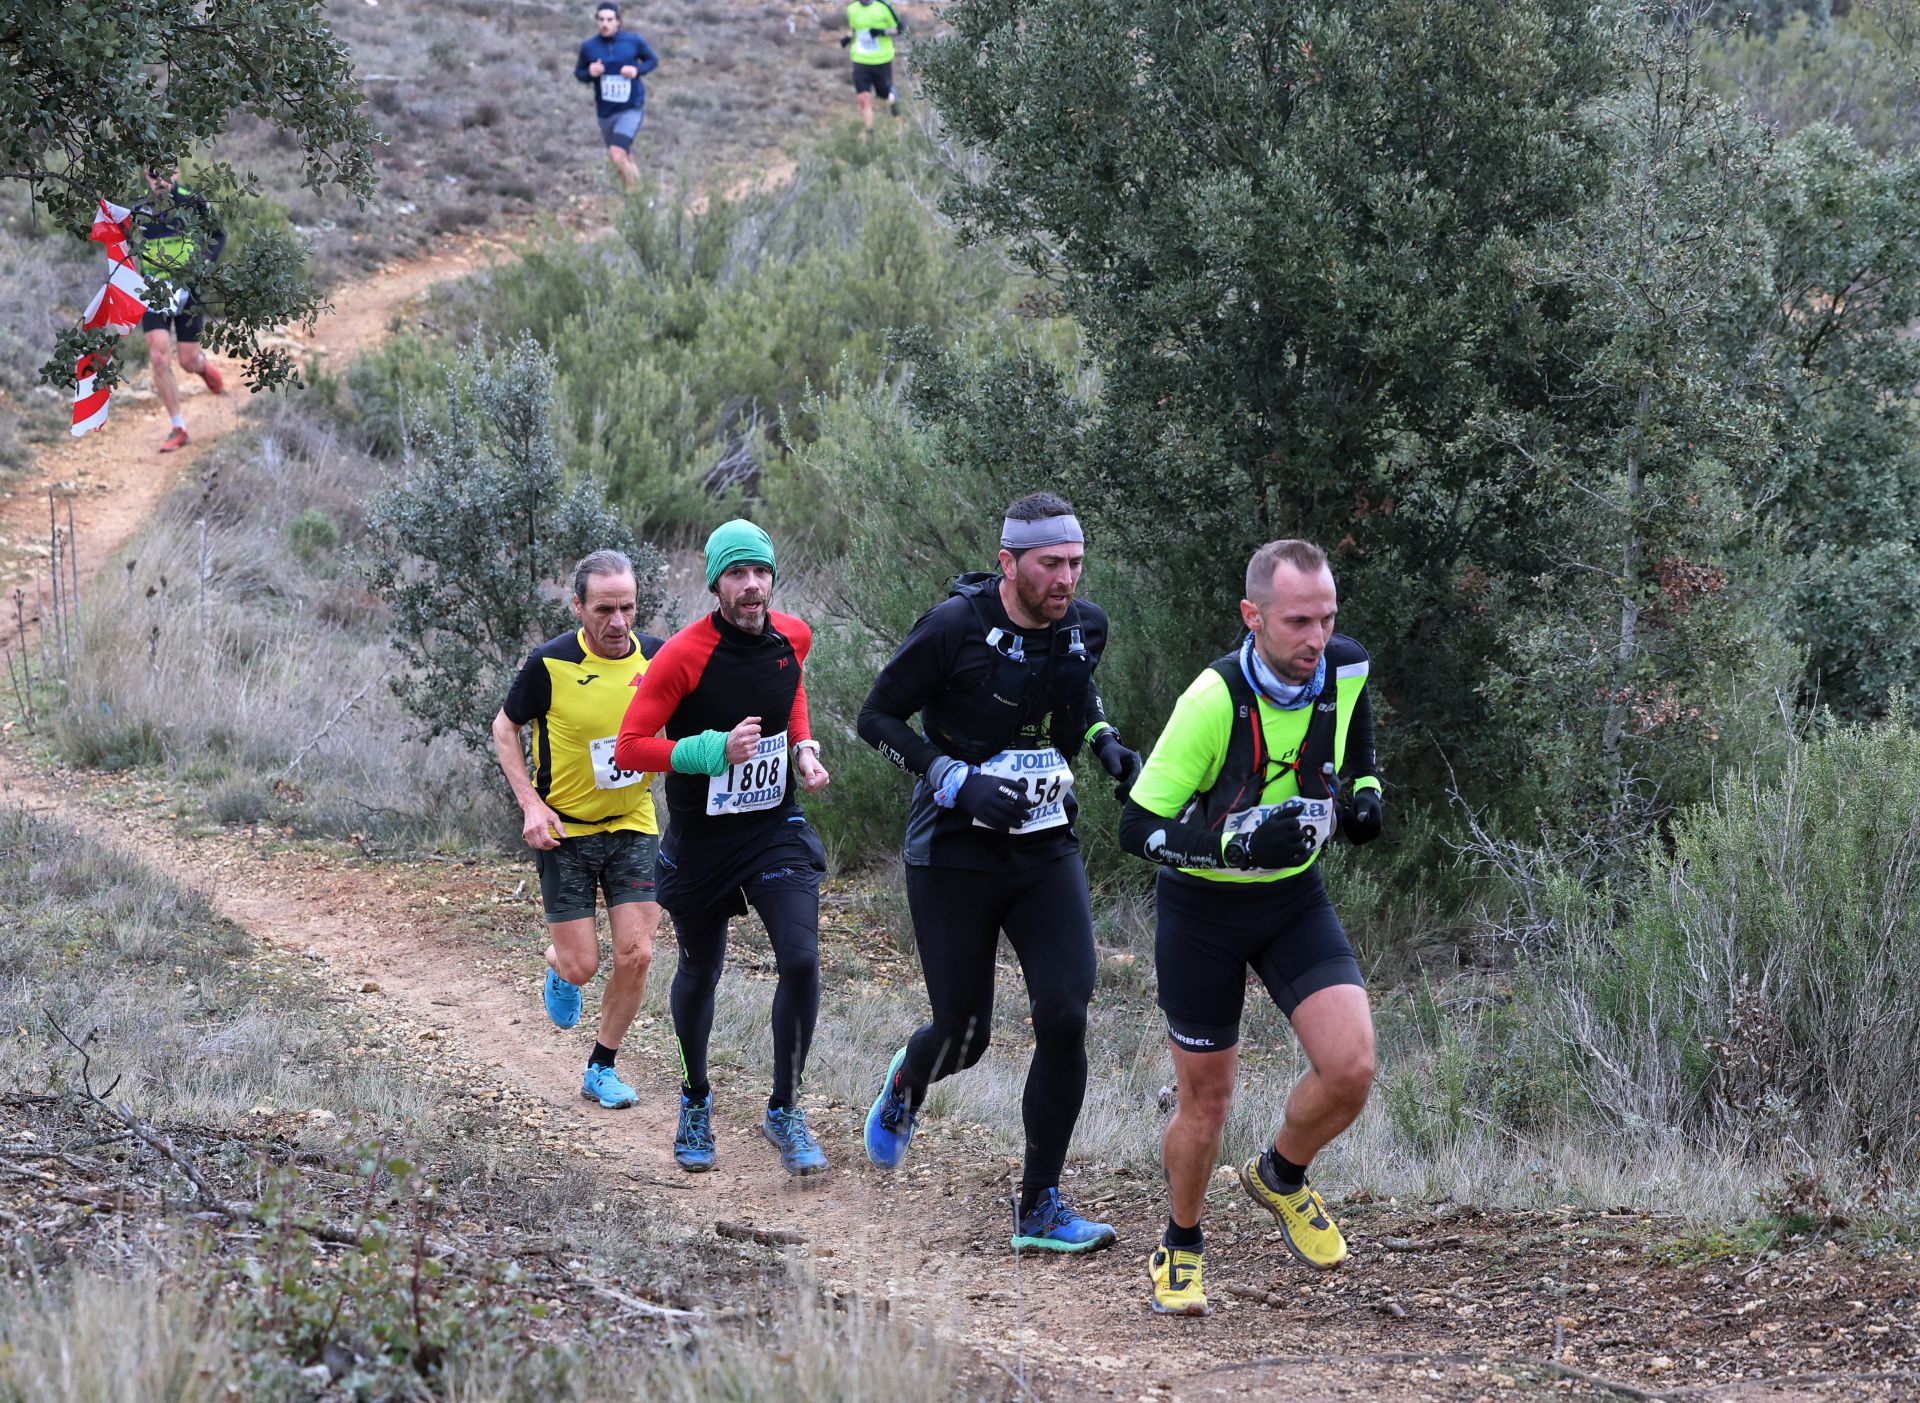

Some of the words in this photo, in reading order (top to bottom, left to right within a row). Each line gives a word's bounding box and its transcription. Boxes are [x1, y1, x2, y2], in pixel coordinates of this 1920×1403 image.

[879, 740, 905, 770] ULTRA
[727, 756, 780, 793] 1808
[732, 785, 782, 807] Joma
[1029, 801, 1061, 821] ma
[1171, 1027, 1215, 1047] LURBEL
